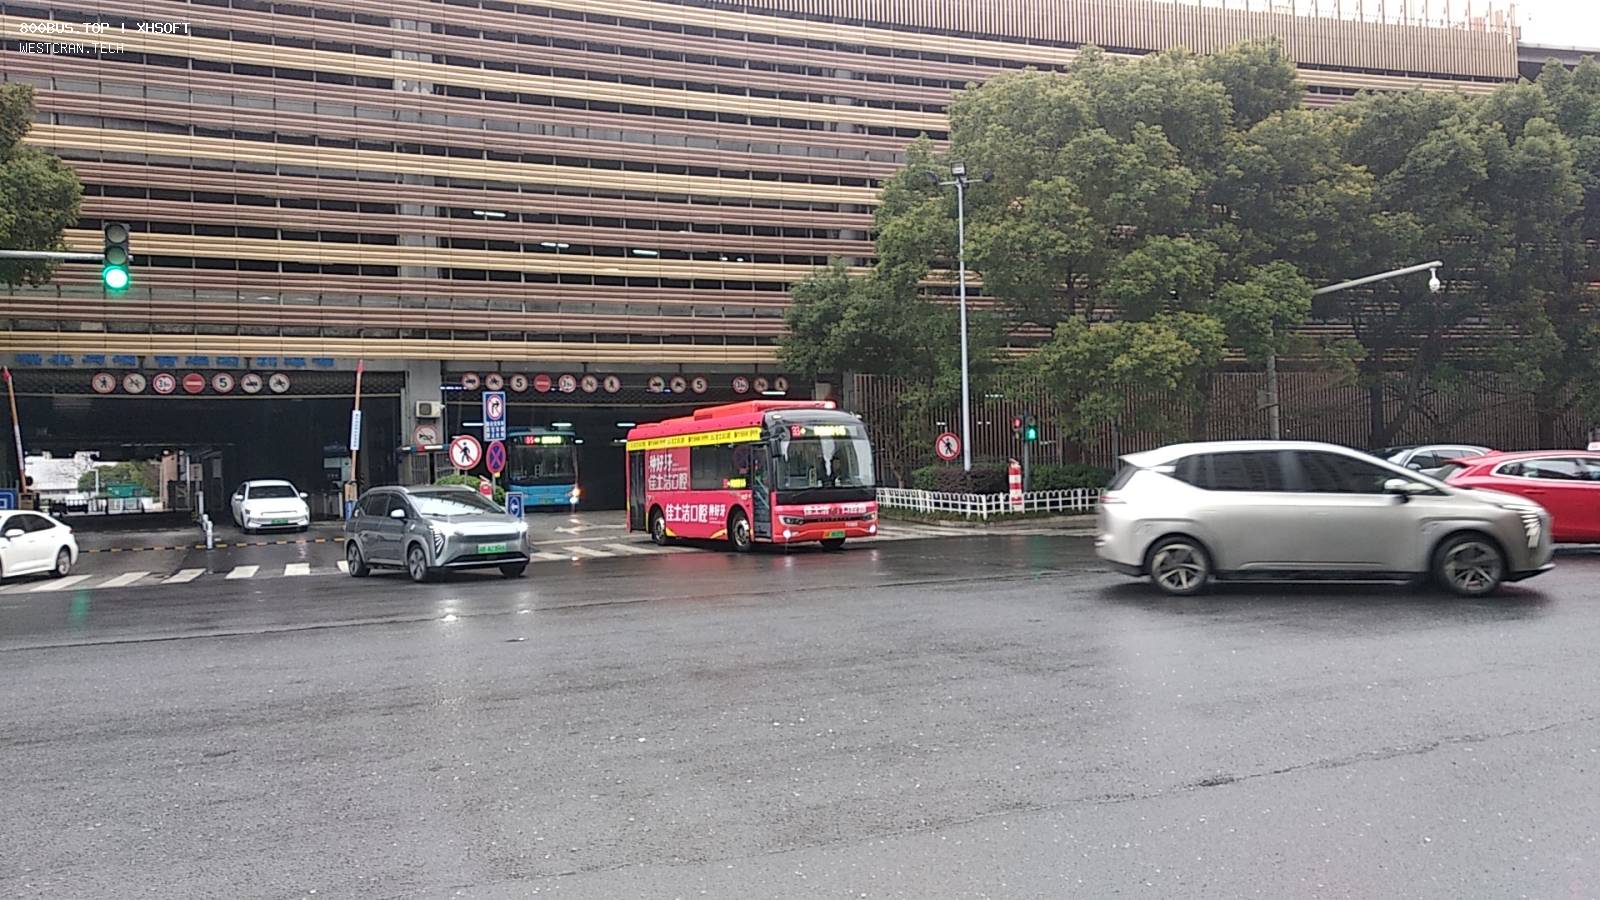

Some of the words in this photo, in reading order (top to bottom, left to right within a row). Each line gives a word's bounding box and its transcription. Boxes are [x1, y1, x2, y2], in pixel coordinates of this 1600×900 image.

[219, 377, 228, 388] 5
[515, 379, 523, 390] 5
[696, 380, 703, 390] 5
